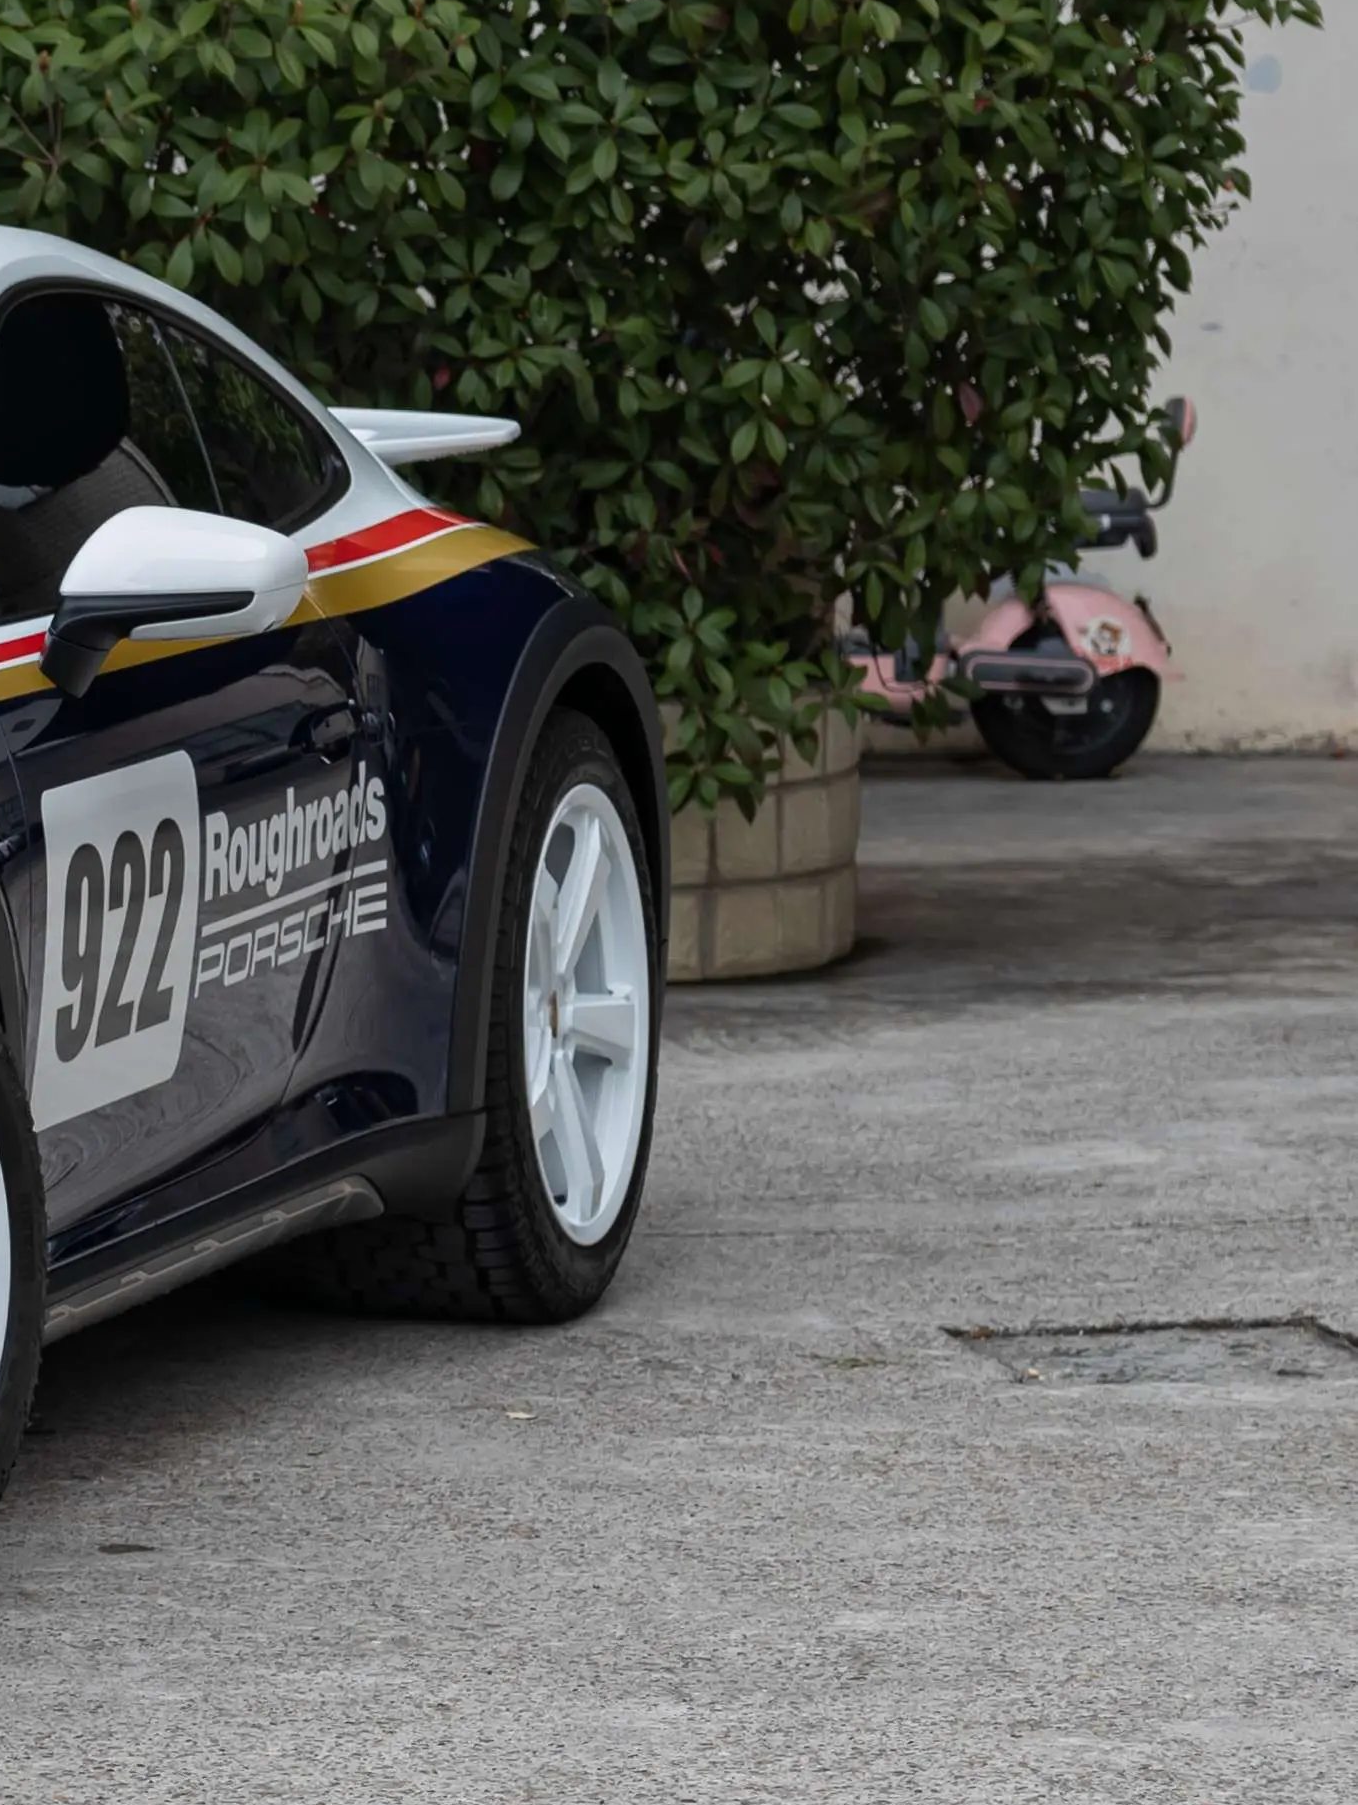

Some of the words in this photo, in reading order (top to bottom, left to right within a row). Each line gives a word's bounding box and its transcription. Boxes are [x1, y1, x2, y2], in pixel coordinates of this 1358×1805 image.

[204, 761, 386, 902] Roughroads
[55, 817, 185, 1063] 922
[194, 882, 387, 999] PORSCHE
